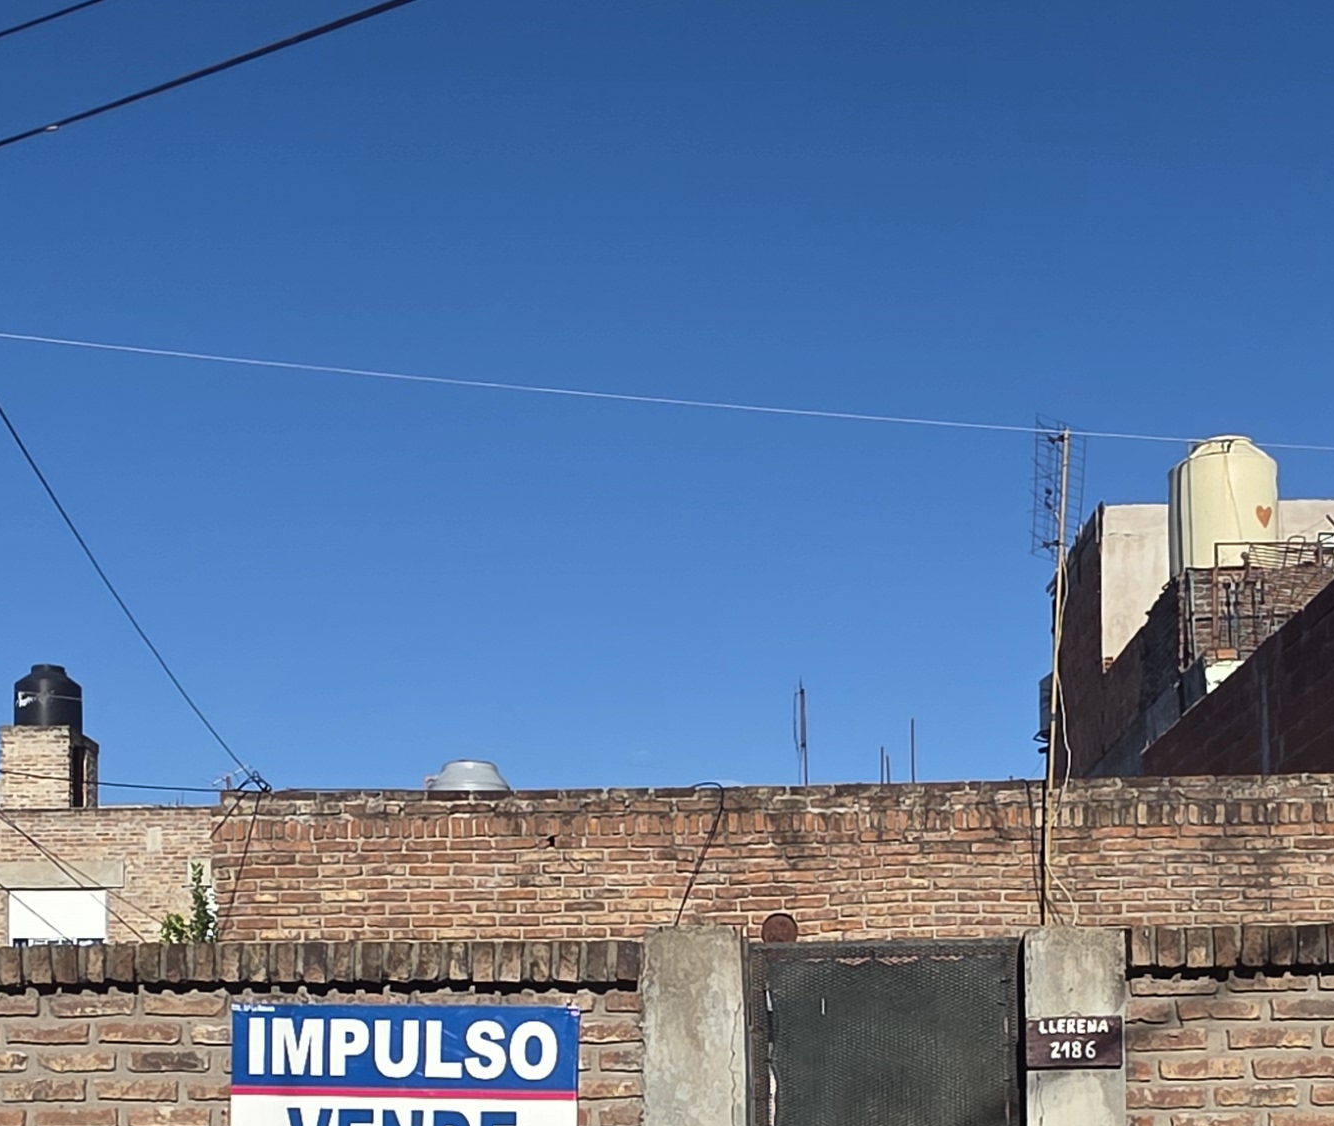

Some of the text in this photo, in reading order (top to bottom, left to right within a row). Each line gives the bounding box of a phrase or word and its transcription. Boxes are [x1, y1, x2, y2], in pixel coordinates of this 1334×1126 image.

[1038, 1018, 1109, 1034] LLERENA
[248, 1017, 557, 1081] IMPULSO
[1049, 1040, 1096, 1059] 2186
